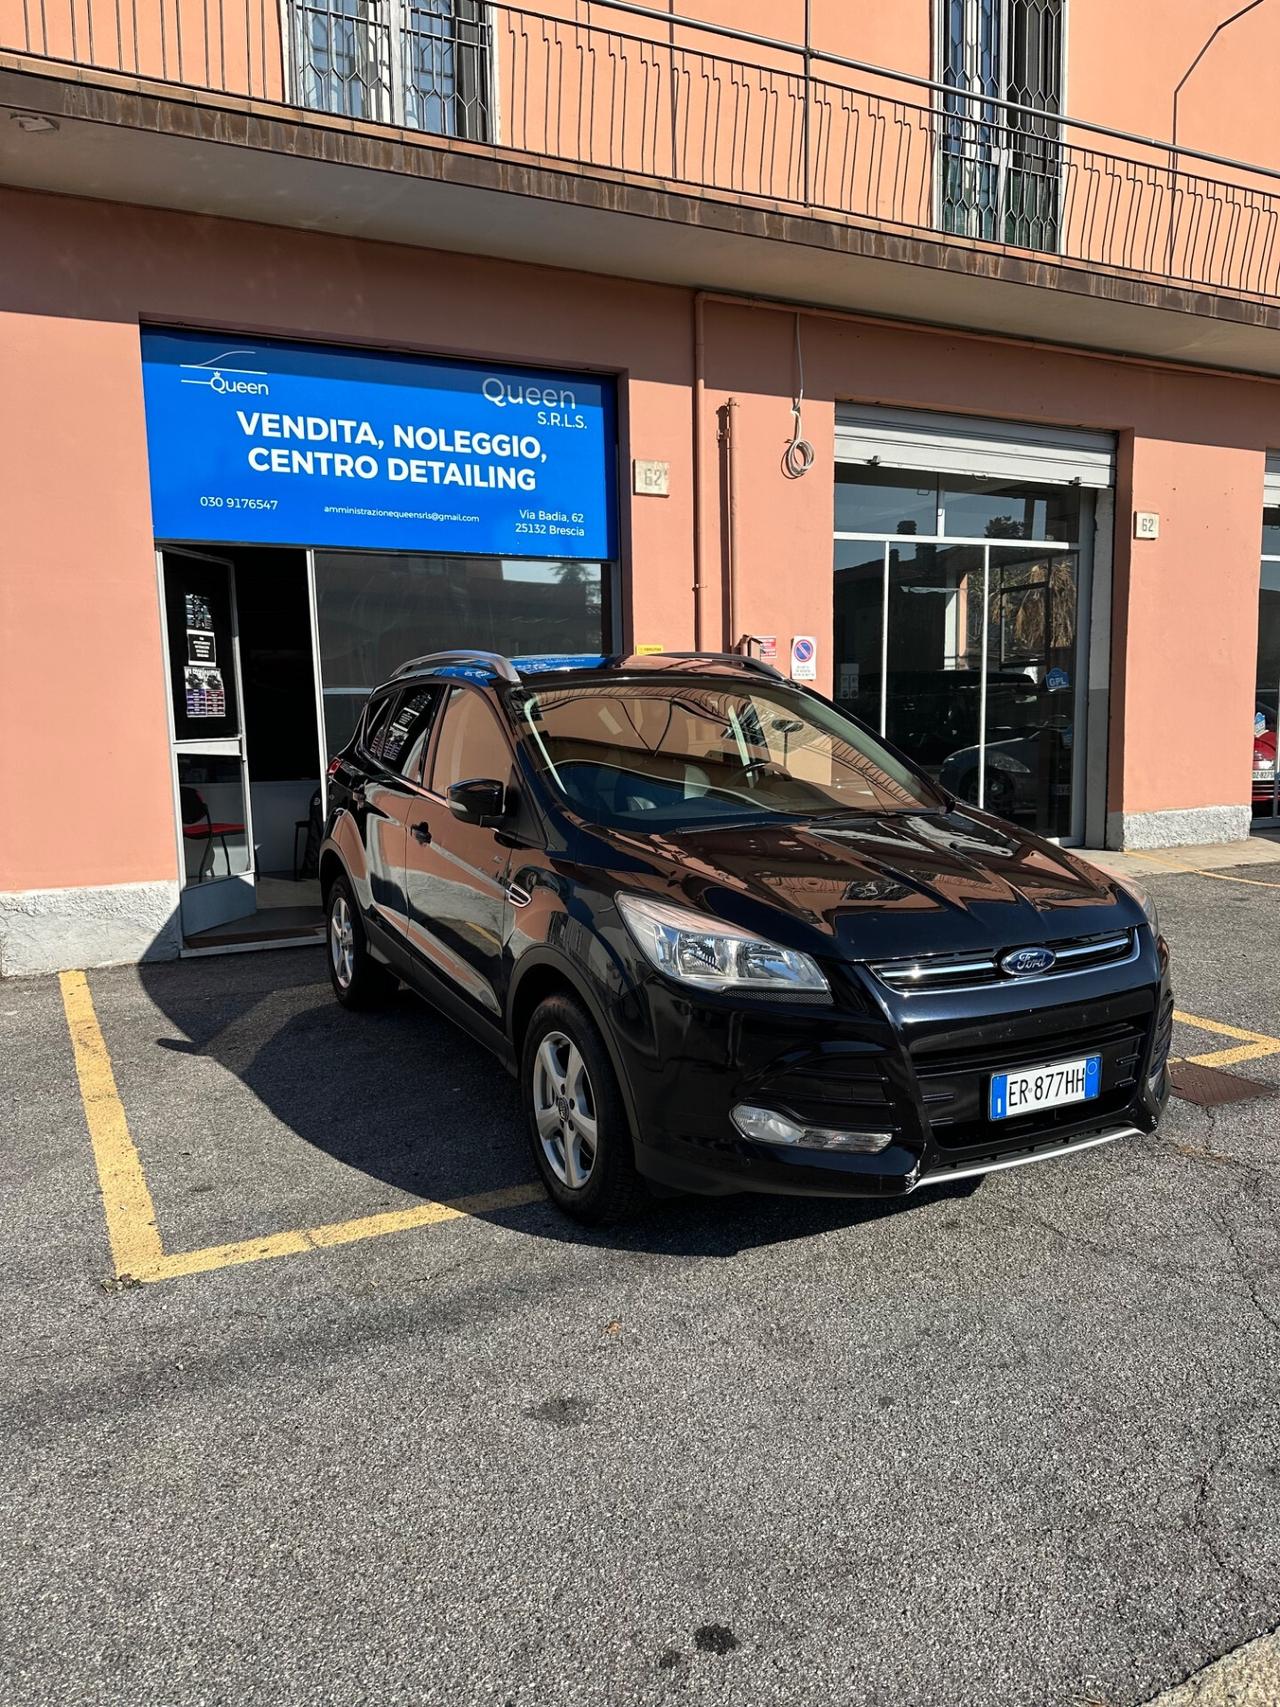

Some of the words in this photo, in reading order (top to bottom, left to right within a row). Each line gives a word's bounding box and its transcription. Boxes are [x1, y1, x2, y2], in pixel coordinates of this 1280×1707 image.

[209, 374, 269, 395] Queen
[482, 377, 576, 409] Queen
[537, 411, 588, 429] S.R.L.S.
[236, 410, 384, 450] VENDITA,
[393, 424, 548, 463] NOLEGGIO,
[248, 447, 379, 480] CENTRO
[388, 457, 537, 491] DETAILING
[200, 496, 224, 508] 030
[226, 497, 278, 510] 9176547
[324, 506, 480, 523] amministrazionequeensrls@gmail.com
[519, 509, 536, 520] Via
[538, 510, 570, 524] Badia,
[571, 512, 585, 523] 62
[515, 522, 547, 535] 25132
[548, 524, 585, 537] Brescia
[1141, 518, 1154, 532] 62
[1016, 952, 1046, 970] Ford
[1009, 1078, 1028, 1107] ER
[1034, 1067, 1085, 1101] 877HH
